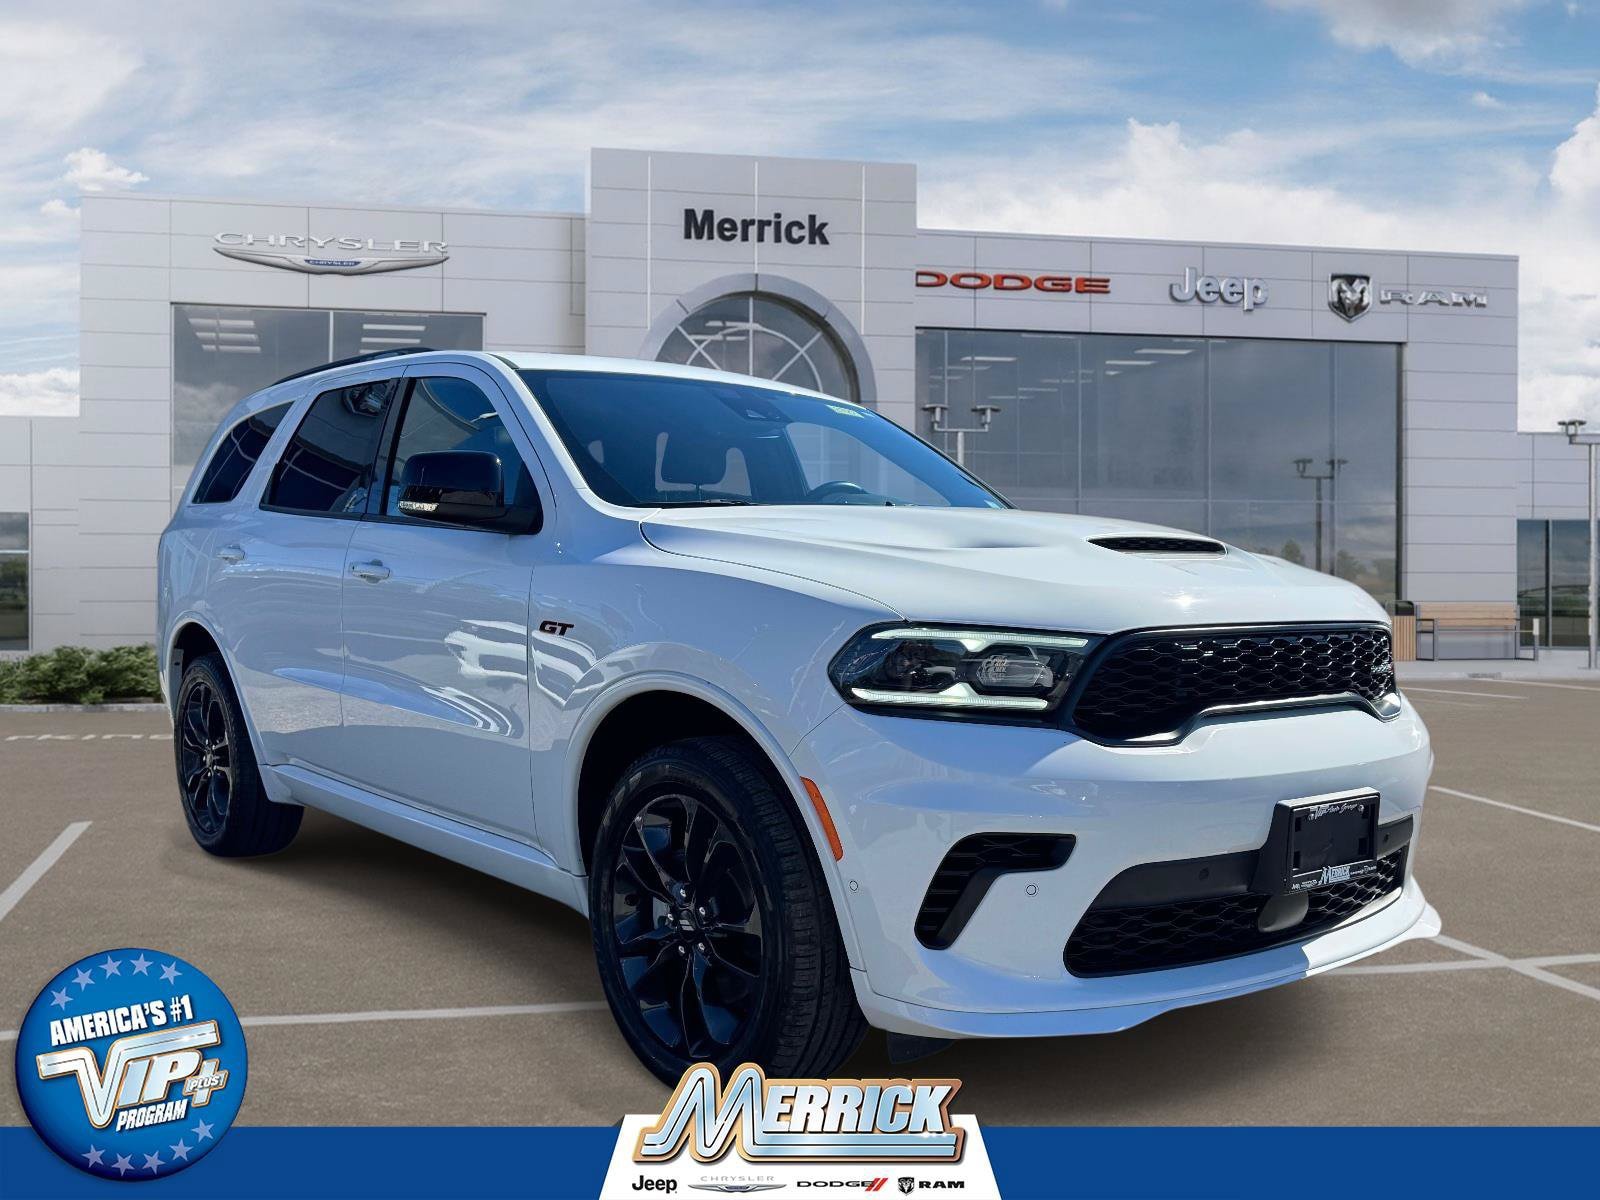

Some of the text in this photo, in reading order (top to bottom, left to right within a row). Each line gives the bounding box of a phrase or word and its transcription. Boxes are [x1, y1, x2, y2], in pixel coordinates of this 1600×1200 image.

[684, 208, 830, 245] Merrick
[213, 232, 449, 253] CHRYSLER
[915, 271, 1111, 294] DODGE
[1170, 266, 1270, 312] Jeep
[1380, 289, 1488, 308] RAM
[539, 620, 575, 636] GT
